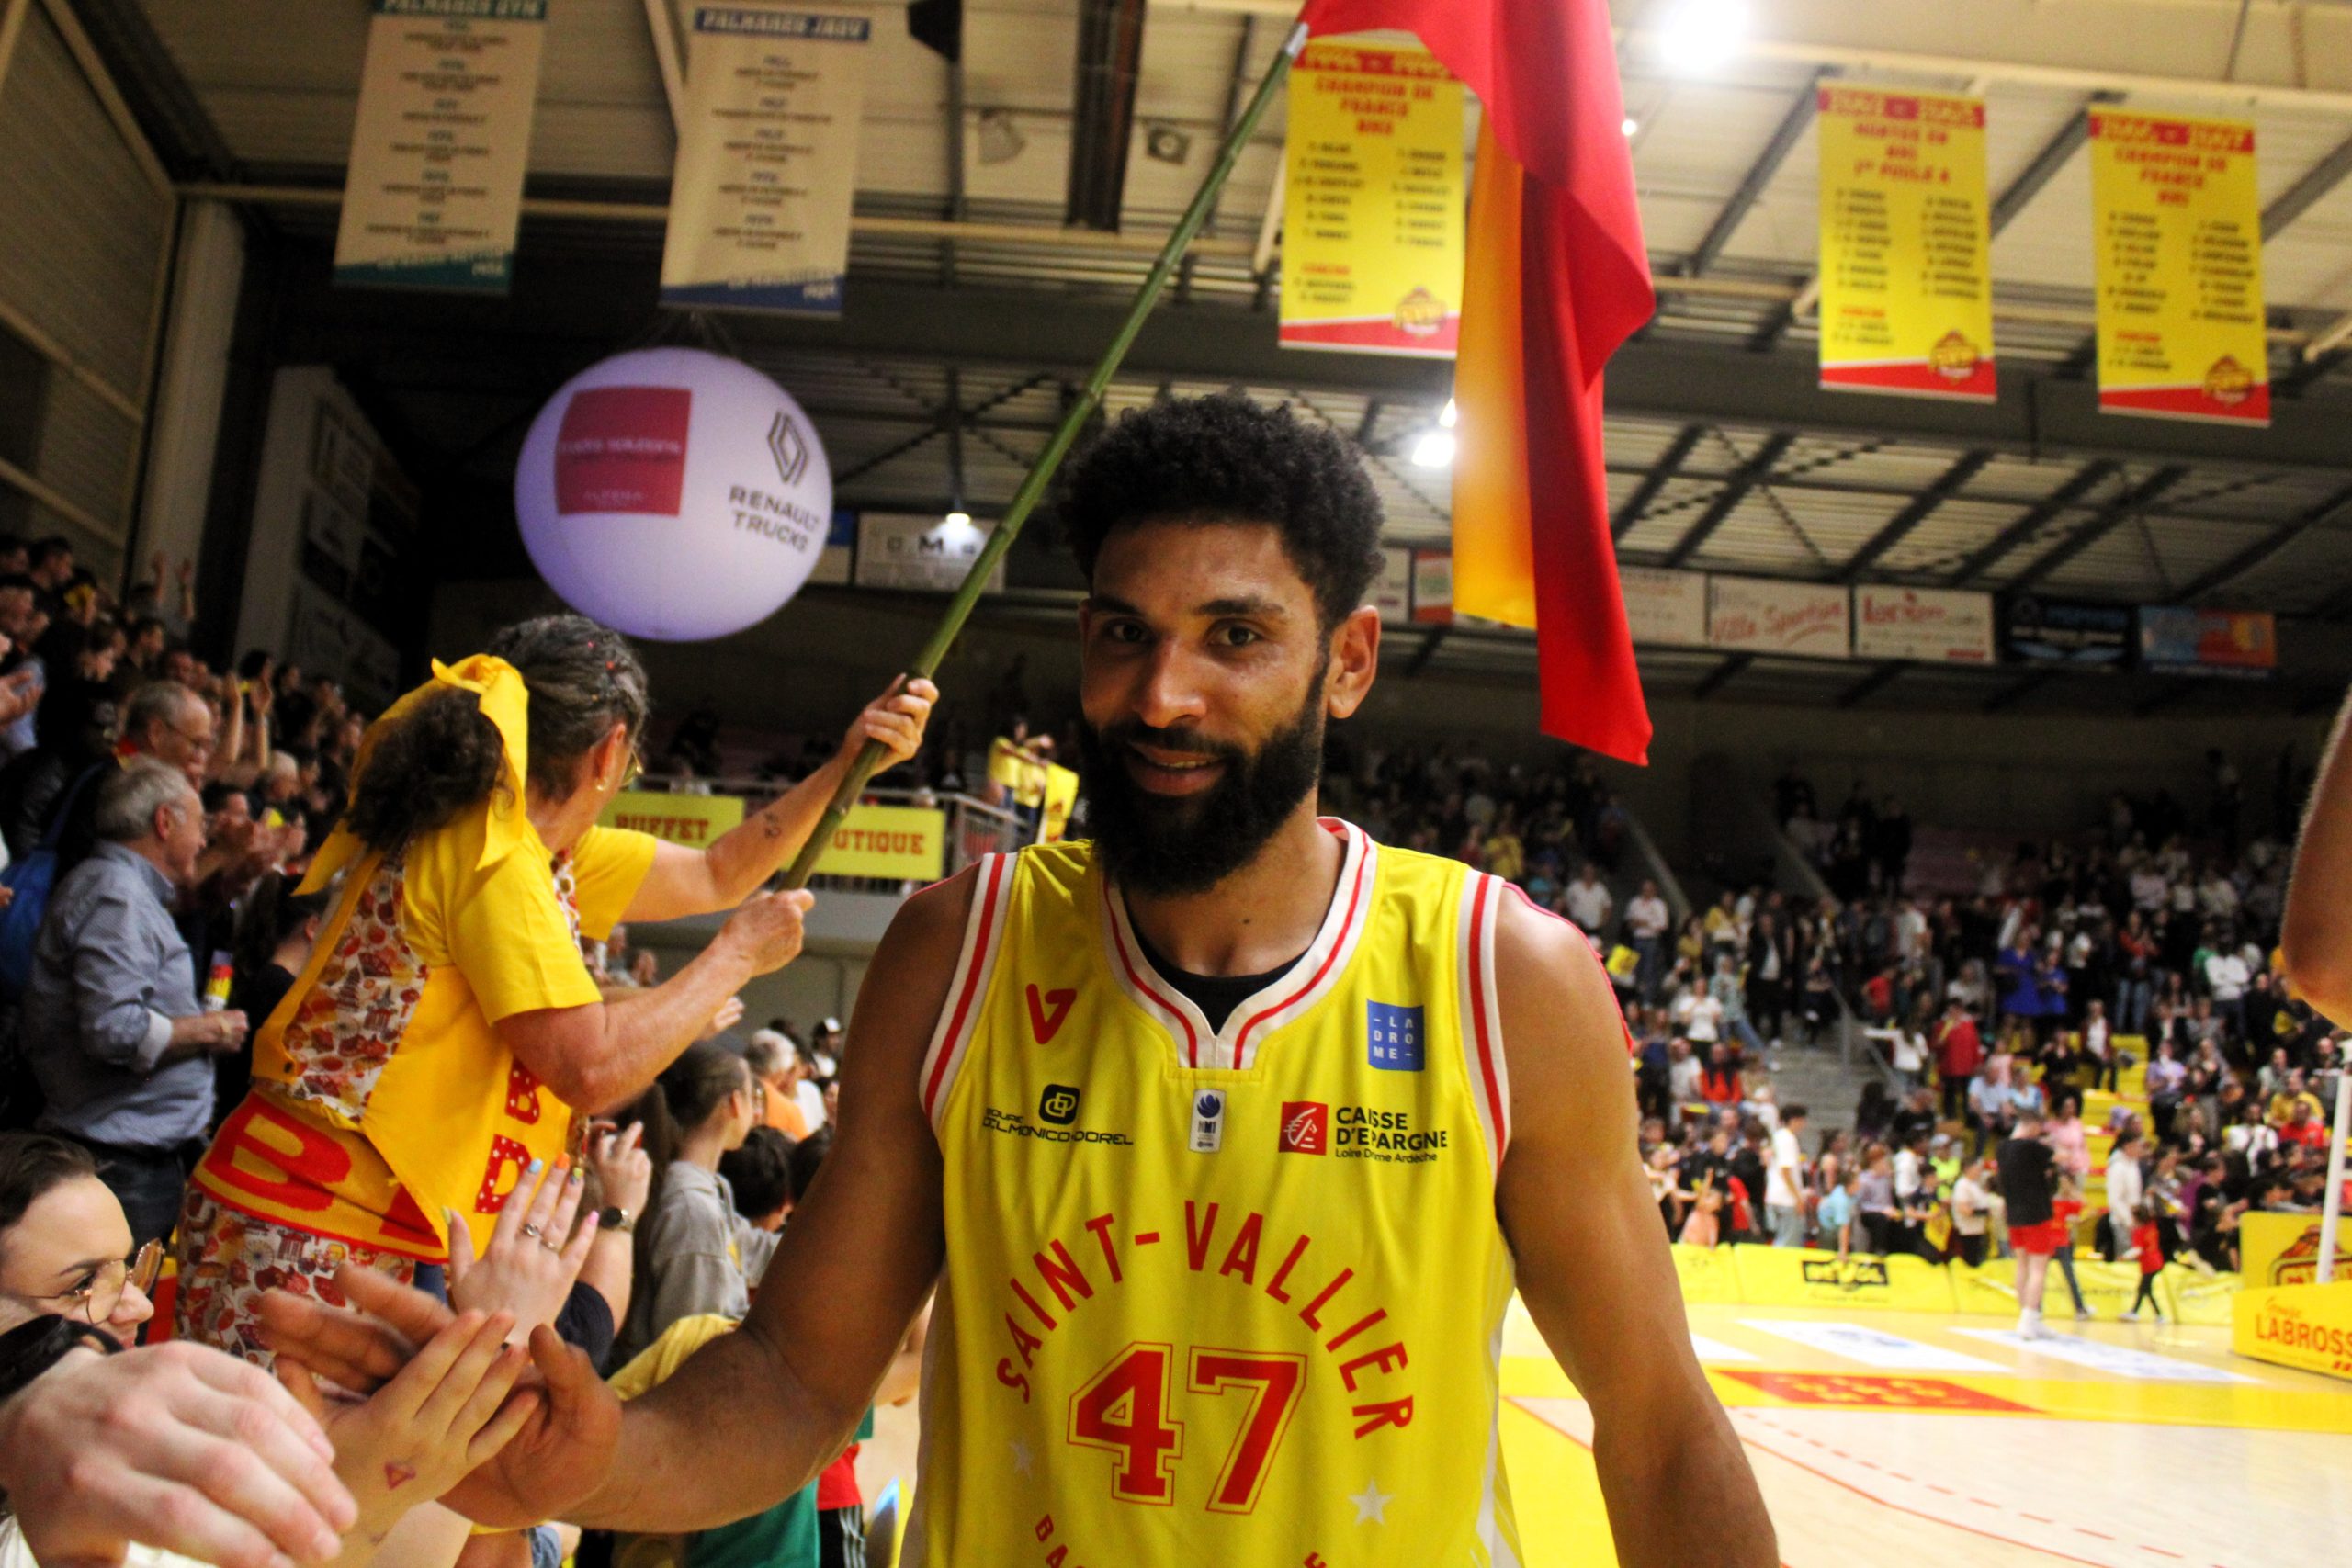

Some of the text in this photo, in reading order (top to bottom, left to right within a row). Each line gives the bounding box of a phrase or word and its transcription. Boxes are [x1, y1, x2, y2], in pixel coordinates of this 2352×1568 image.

[729, 484, 820, 532] RENAULT
[733, 509, 808, 553] TRUCKS
[616, 814, 708, 840] BUFFET
[831, 829, 925, 855] UTIQUE
[1335, 1148, 1362, 1158] Loire
[996, 1200, 1414, 1442] SAINT-VALLIER
[1066, 1340, 1309, 1516] 47
